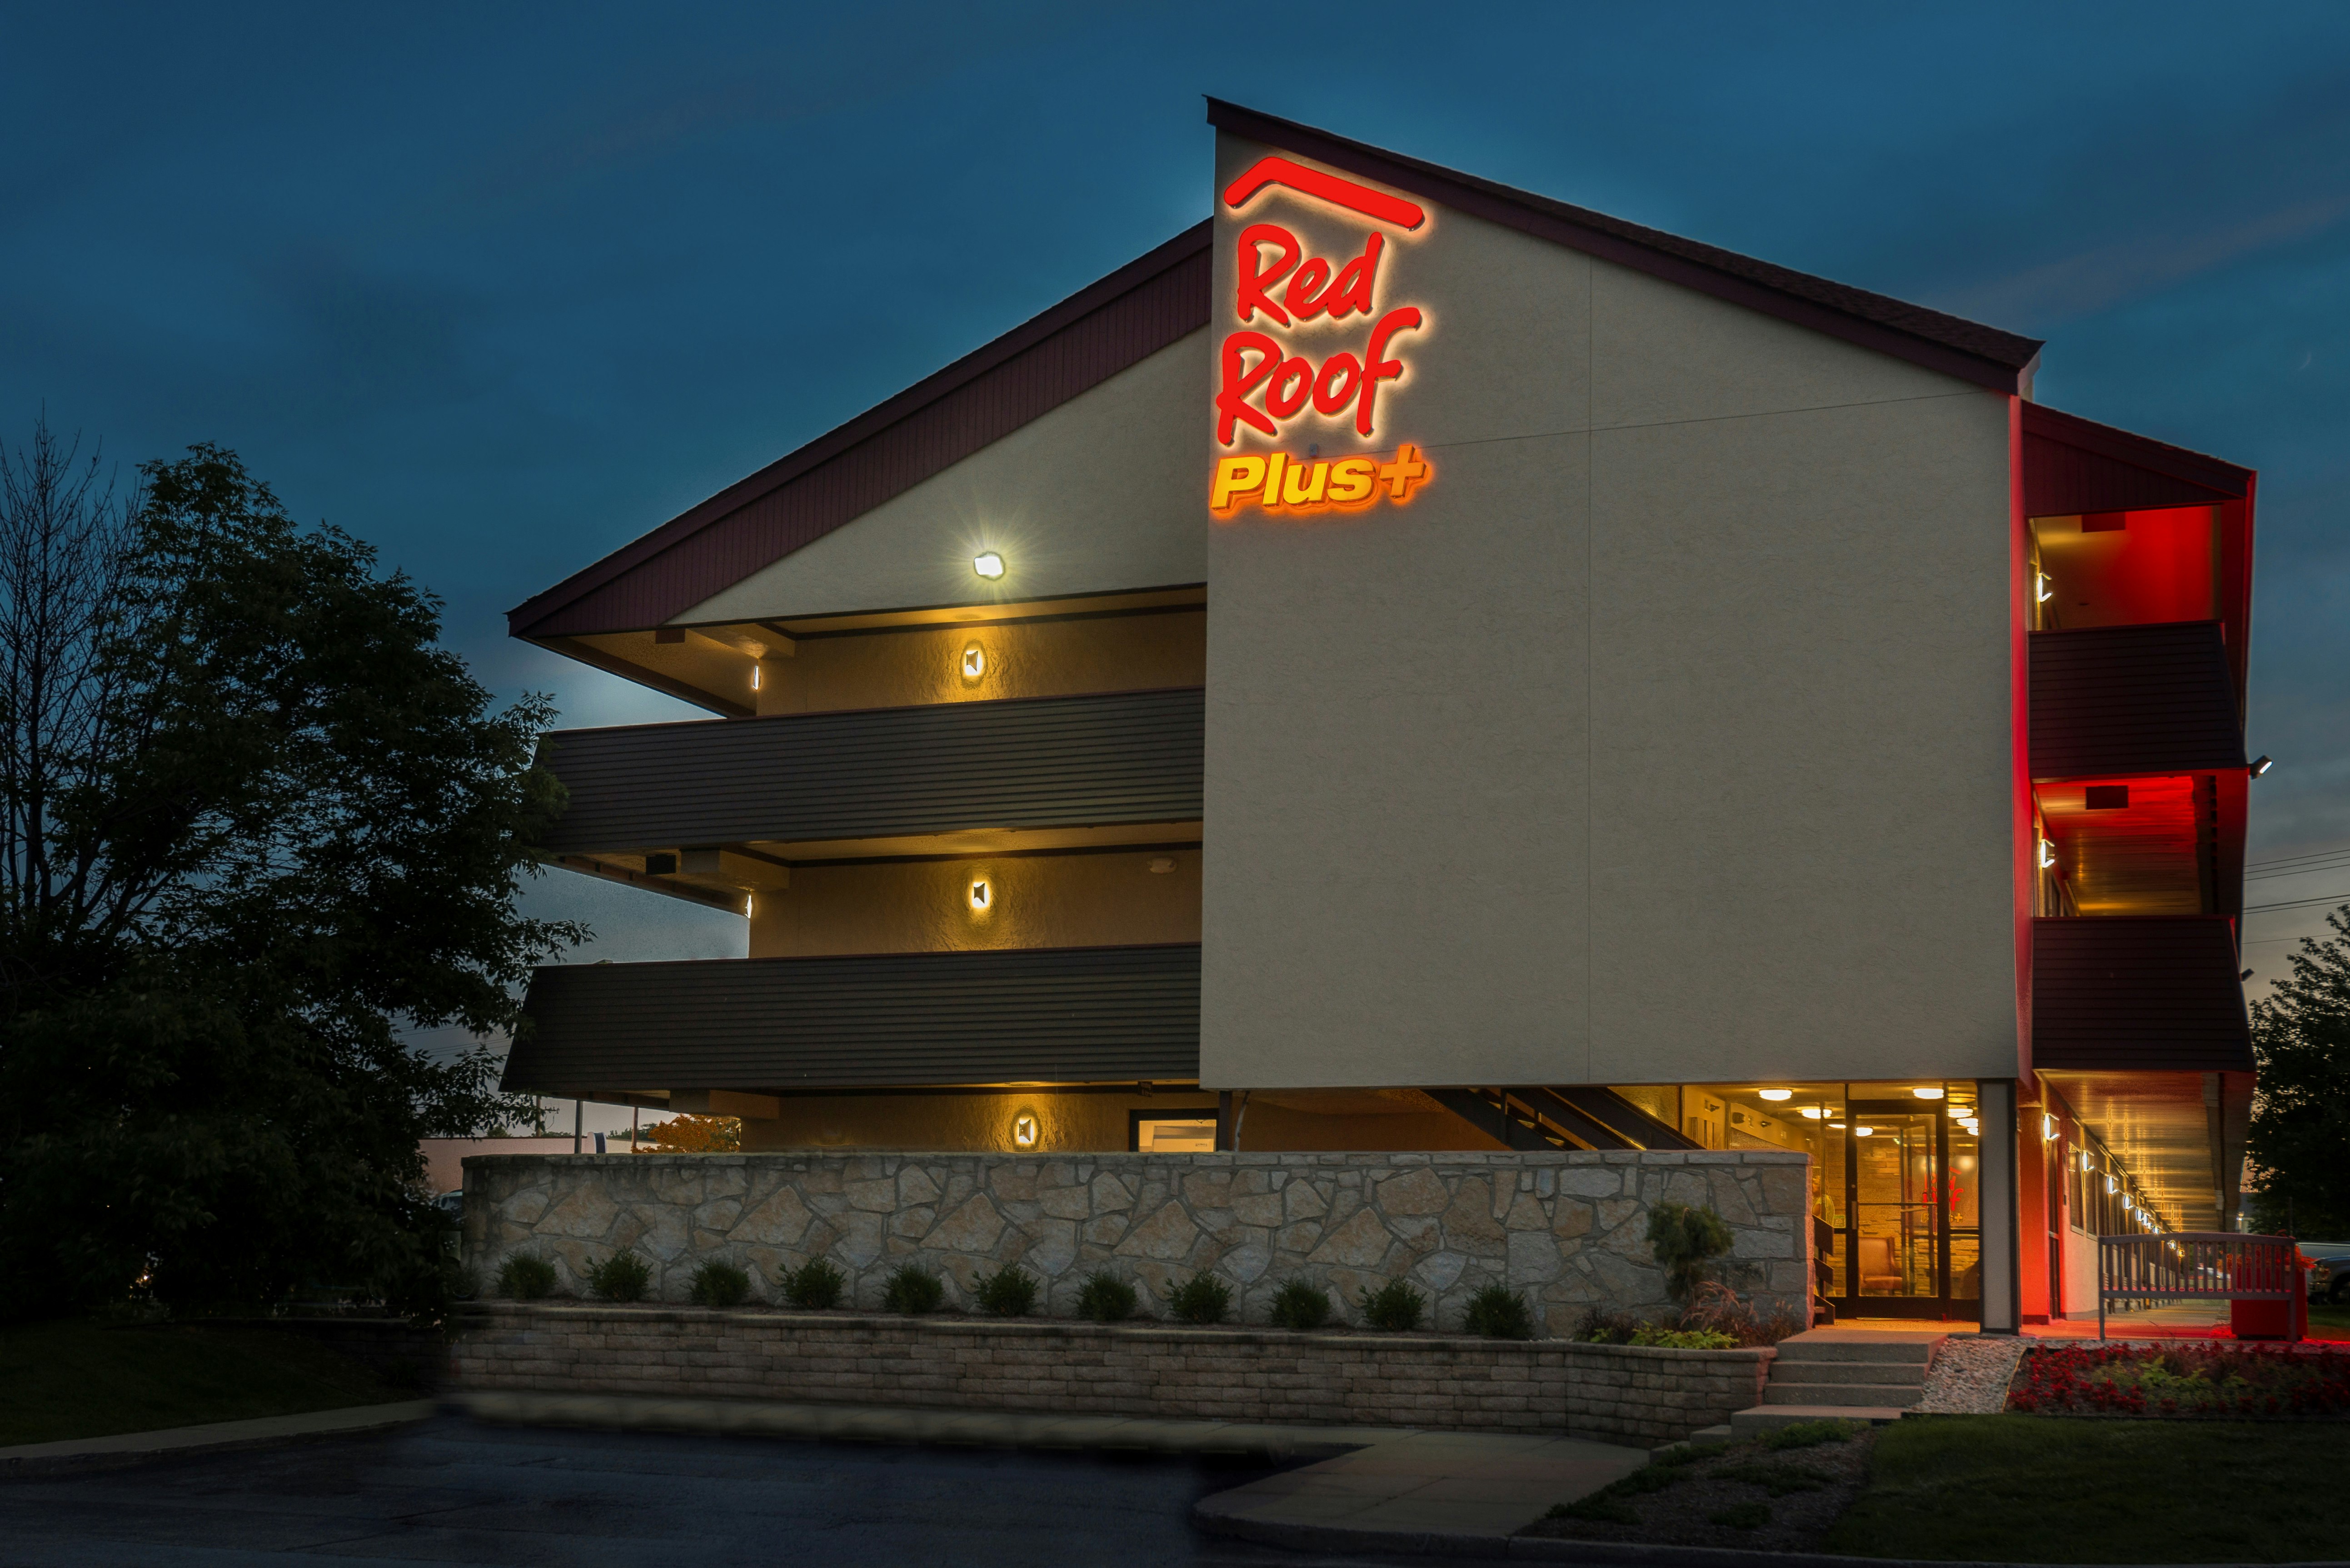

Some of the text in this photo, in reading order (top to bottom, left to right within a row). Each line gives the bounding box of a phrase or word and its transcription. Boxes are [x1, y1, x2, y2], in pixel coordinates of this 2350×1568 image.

[1237, 224, 1384, 326] Red
[1216, 307, 1421, 446] Roof
[1211, 444, 1426, 509] Plus+
